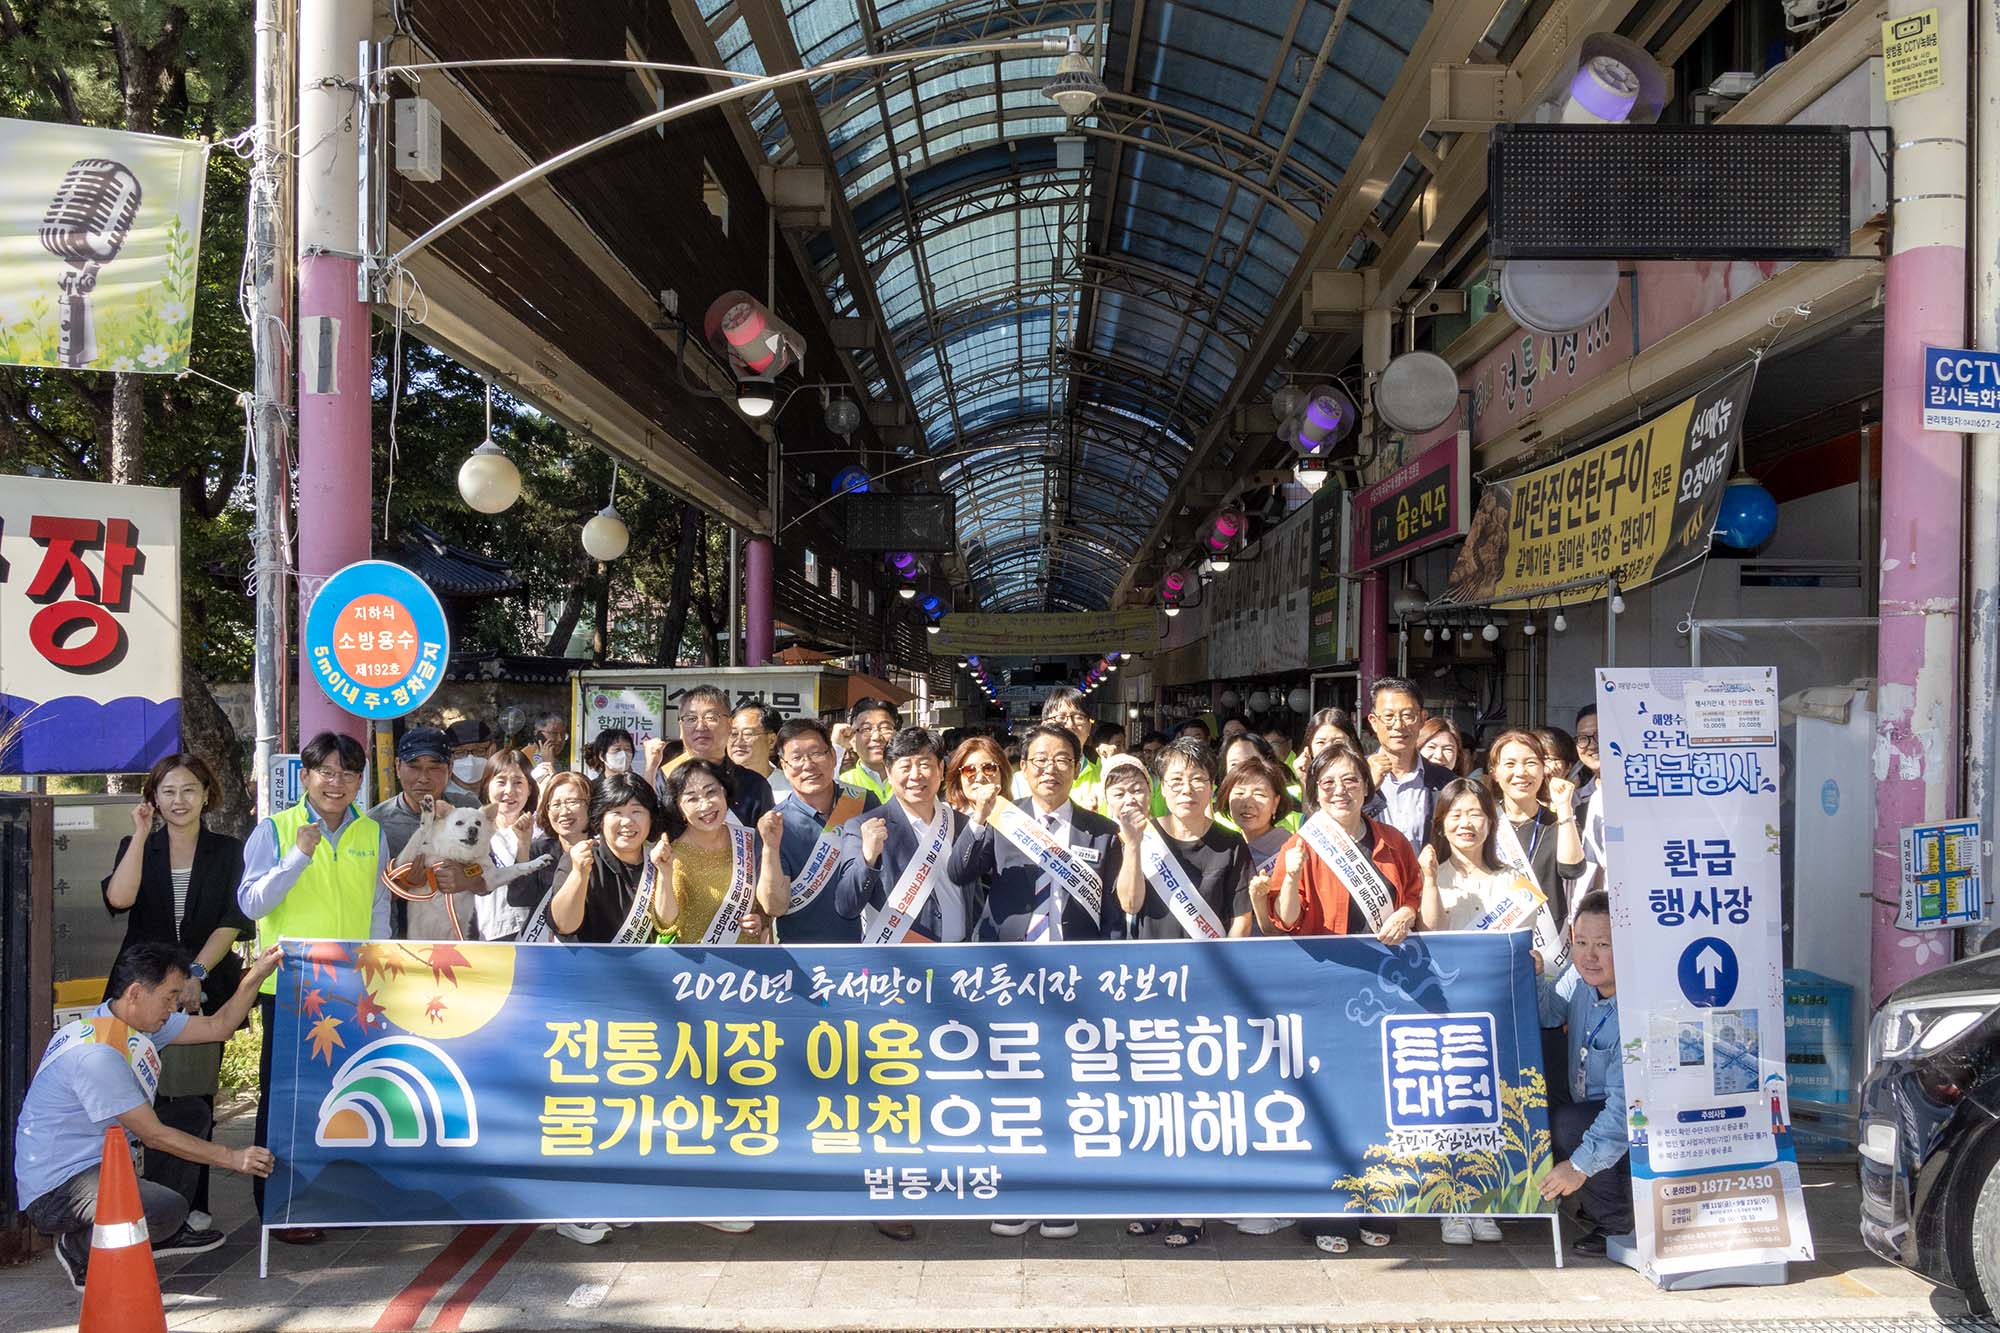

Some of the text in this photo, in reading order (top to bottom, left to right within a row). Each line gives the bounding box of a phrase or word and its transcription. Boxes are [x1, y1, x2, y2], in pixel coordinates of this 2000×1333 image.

[1931, 386, 2000, 409] 감시녹화
[354, 605, 395, 620] 지하식
[338, 630, 414, 651] 소방용수
[355, 663, 401, 677] 제192호
[1652, 714, 1687, 726] 해양수
[1624, 752, 1761, 797] 환급행사
[1664, 839, 1736, 877] 환급
[1648, 886, 1752, 927] 행사장
[673, 963, 1189, 1008] 2026년 추석맞이 전통시장 장보기
[543, 1013, 1321, 1086] 전통시장 이용으로 알뜰하게,
[1392, 1073, 1493, 1118] 대덕
[539, 1090, 1313, 1158] 물가안정 실천으로 함께해요
[1701, 1110, 1726, 1120] 주의사항
[864, 1165, 1002, 1200] 법동시장
[1672, 1175, 1773, 1195] 문의전화 1877-2430
